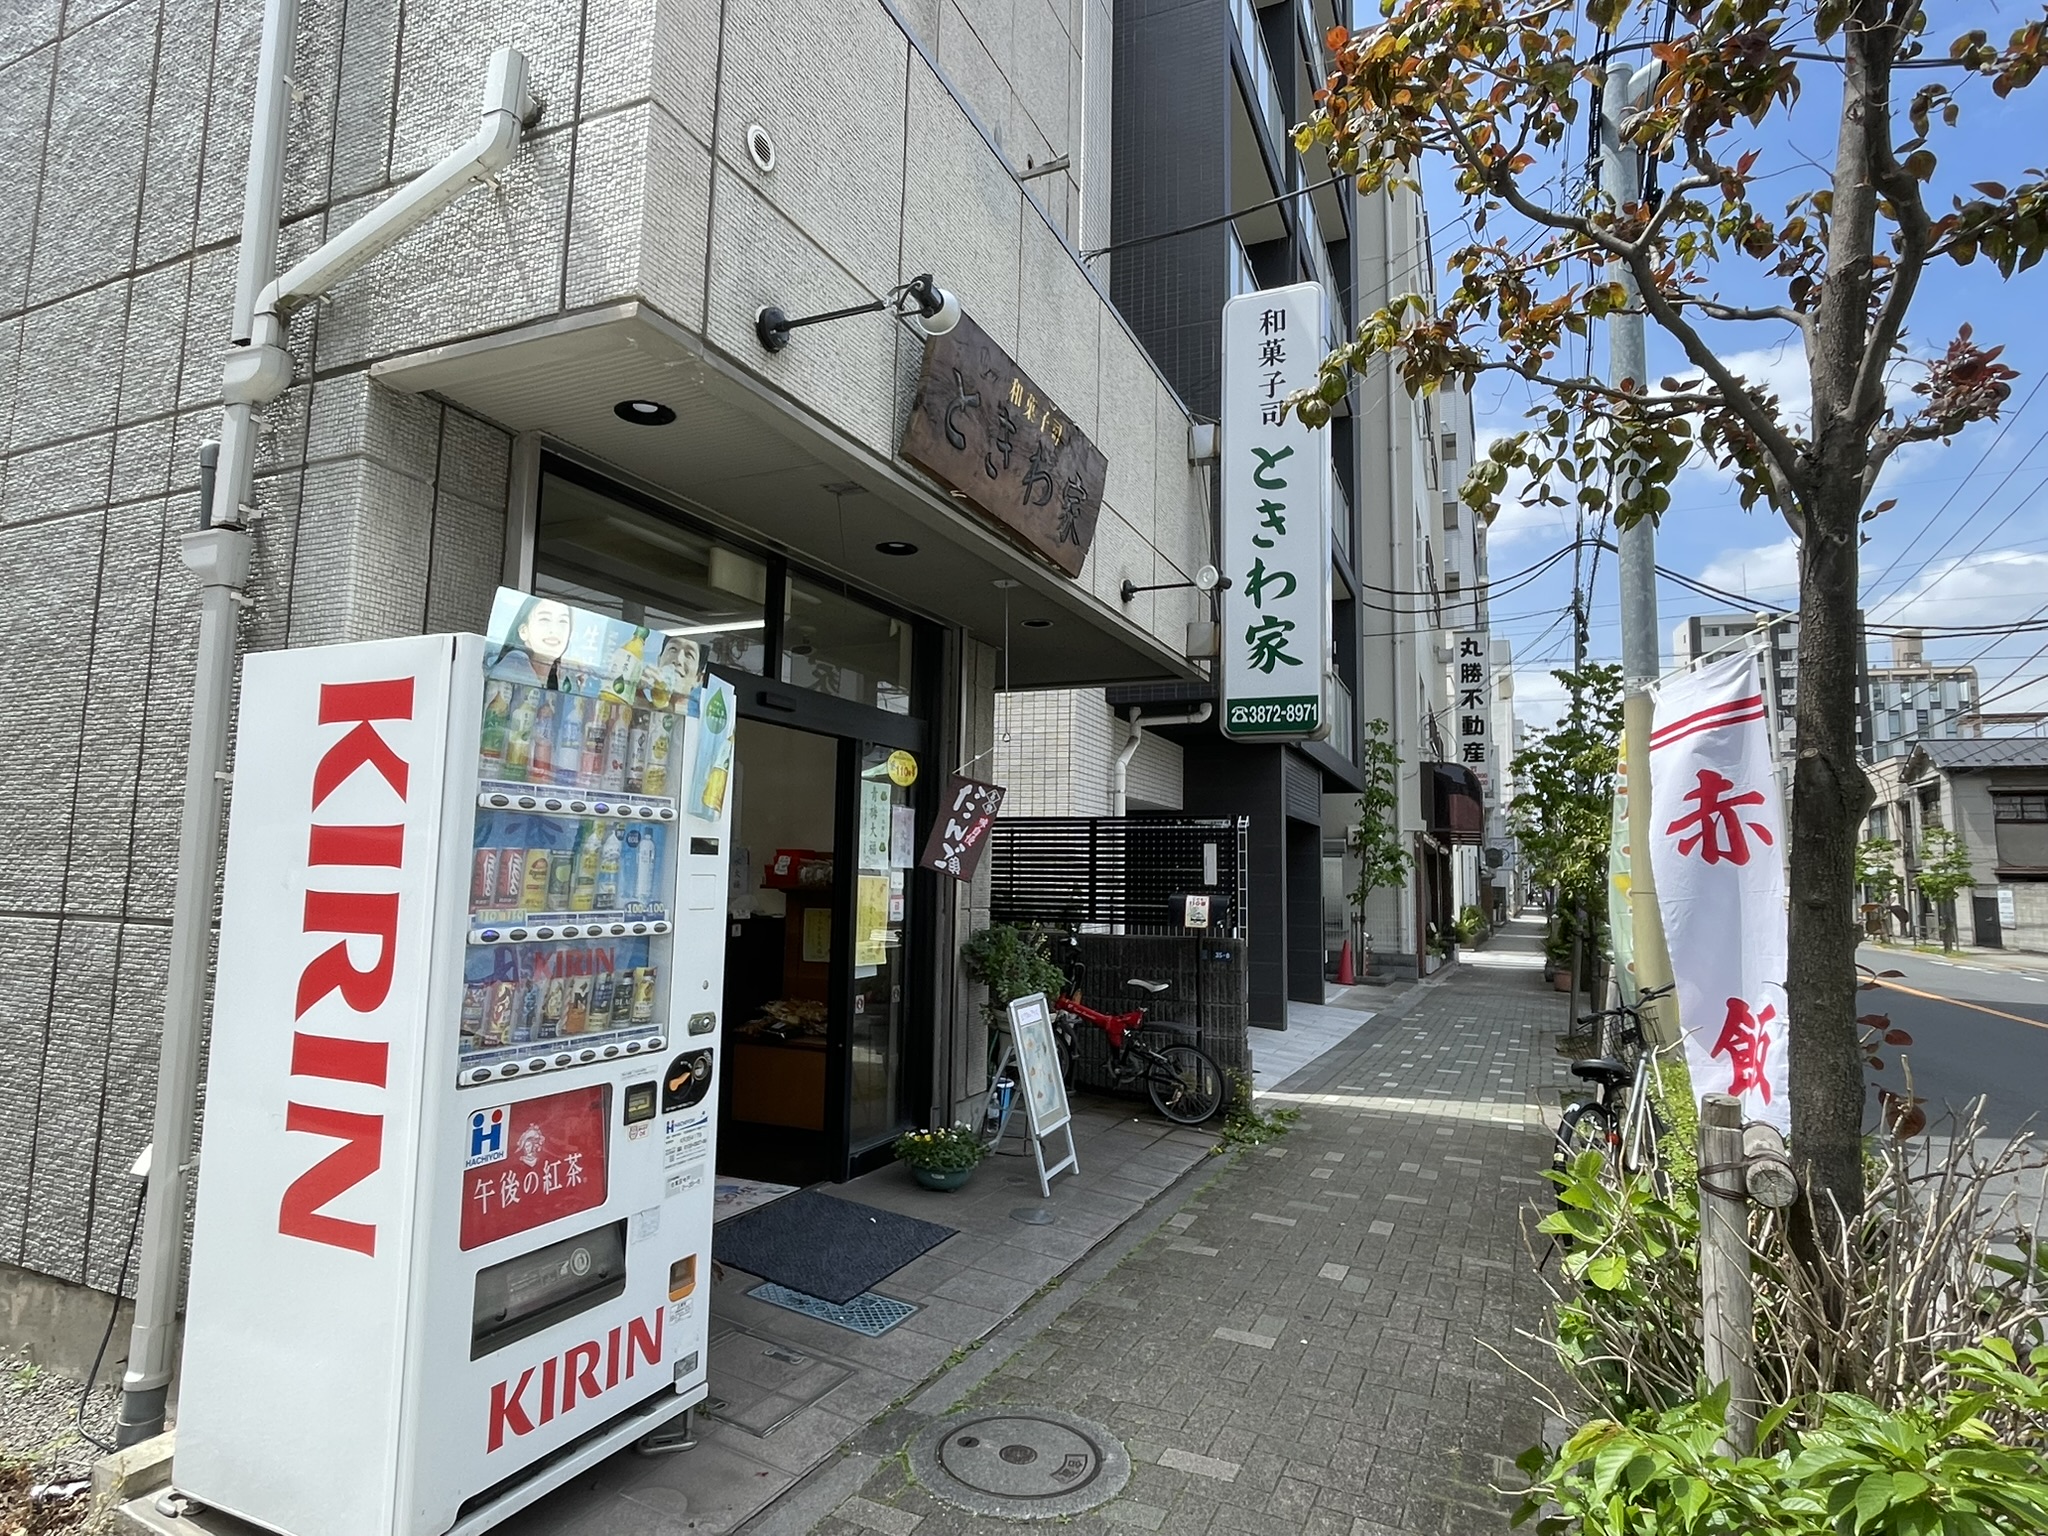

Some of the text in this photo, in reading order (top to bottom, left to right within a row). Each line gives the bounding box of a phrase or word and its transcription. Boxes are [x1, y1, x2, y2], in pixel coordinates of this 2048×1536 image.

[1008, 377, 1064, 447] 和菓子司
[1257, 307, 1287, 428] 和菓子司
[943, 367, 1089, 547] ときわ家
[1243, 444, 1304, 675] ときわ家
[1248, 701, 1318, 726] 3872-8971
[1459, 636, 1486, 763] 丸勝不動産
[933, 783, 986, 872] だんご
[278, 675, 416, 1259] KIRIN
[533, 946, 616, 980] KIRIN
[1664, 768, 1777, 1106] 赤飯
[465, 1150, 504, 1168] HACHIYOH
[473, 1152, 584, 1215] 午後の紅茶
[486, 1305, 665, 1455] KIRIN
